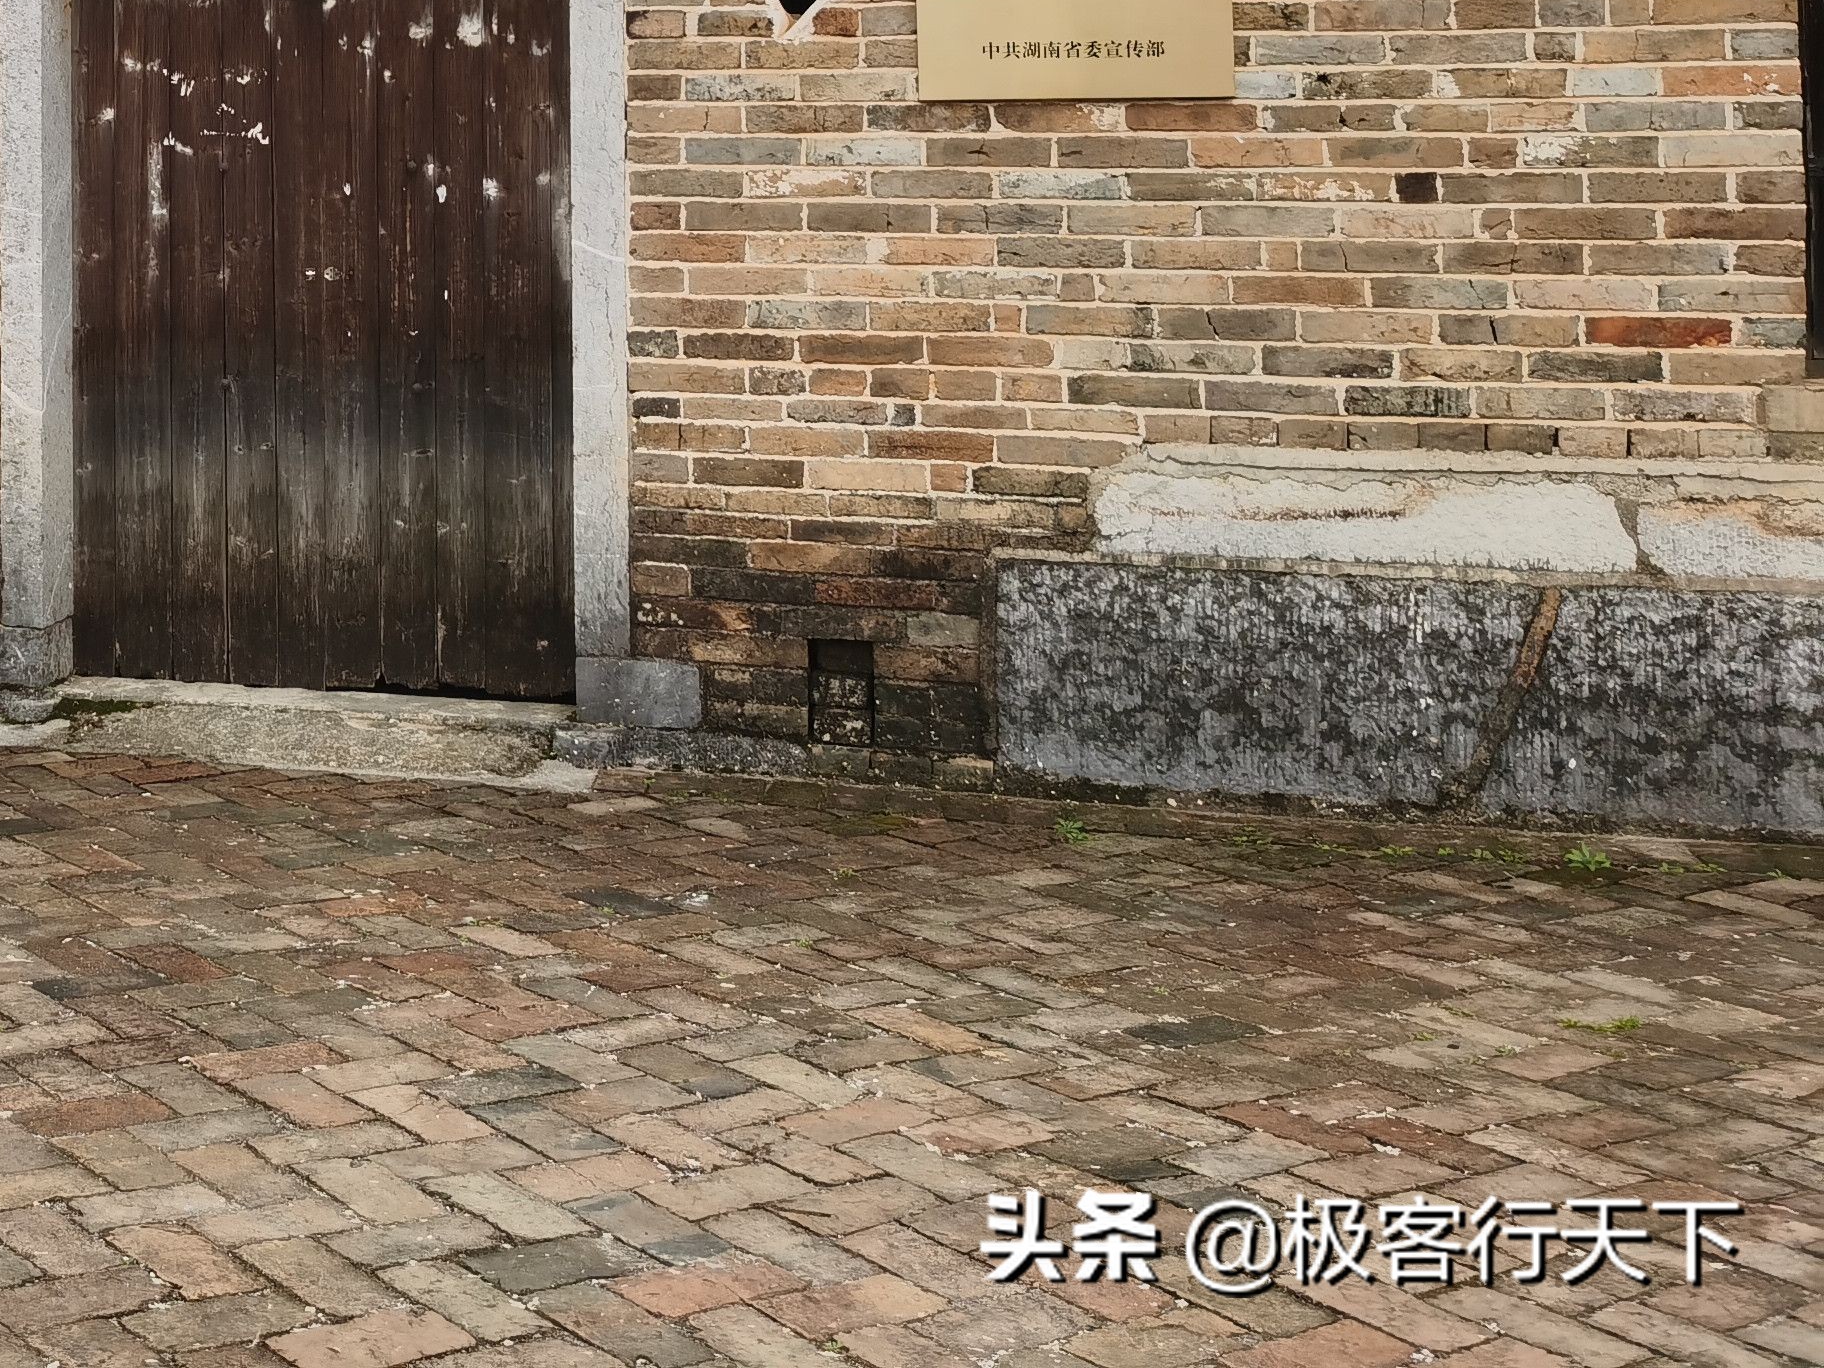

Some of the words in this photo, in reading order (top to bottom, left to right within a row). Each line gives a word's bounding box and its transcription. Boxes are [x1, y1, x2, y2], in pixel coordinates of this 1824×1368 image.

[982, 39, 1166, 60] 中共湖南省委宣传部
